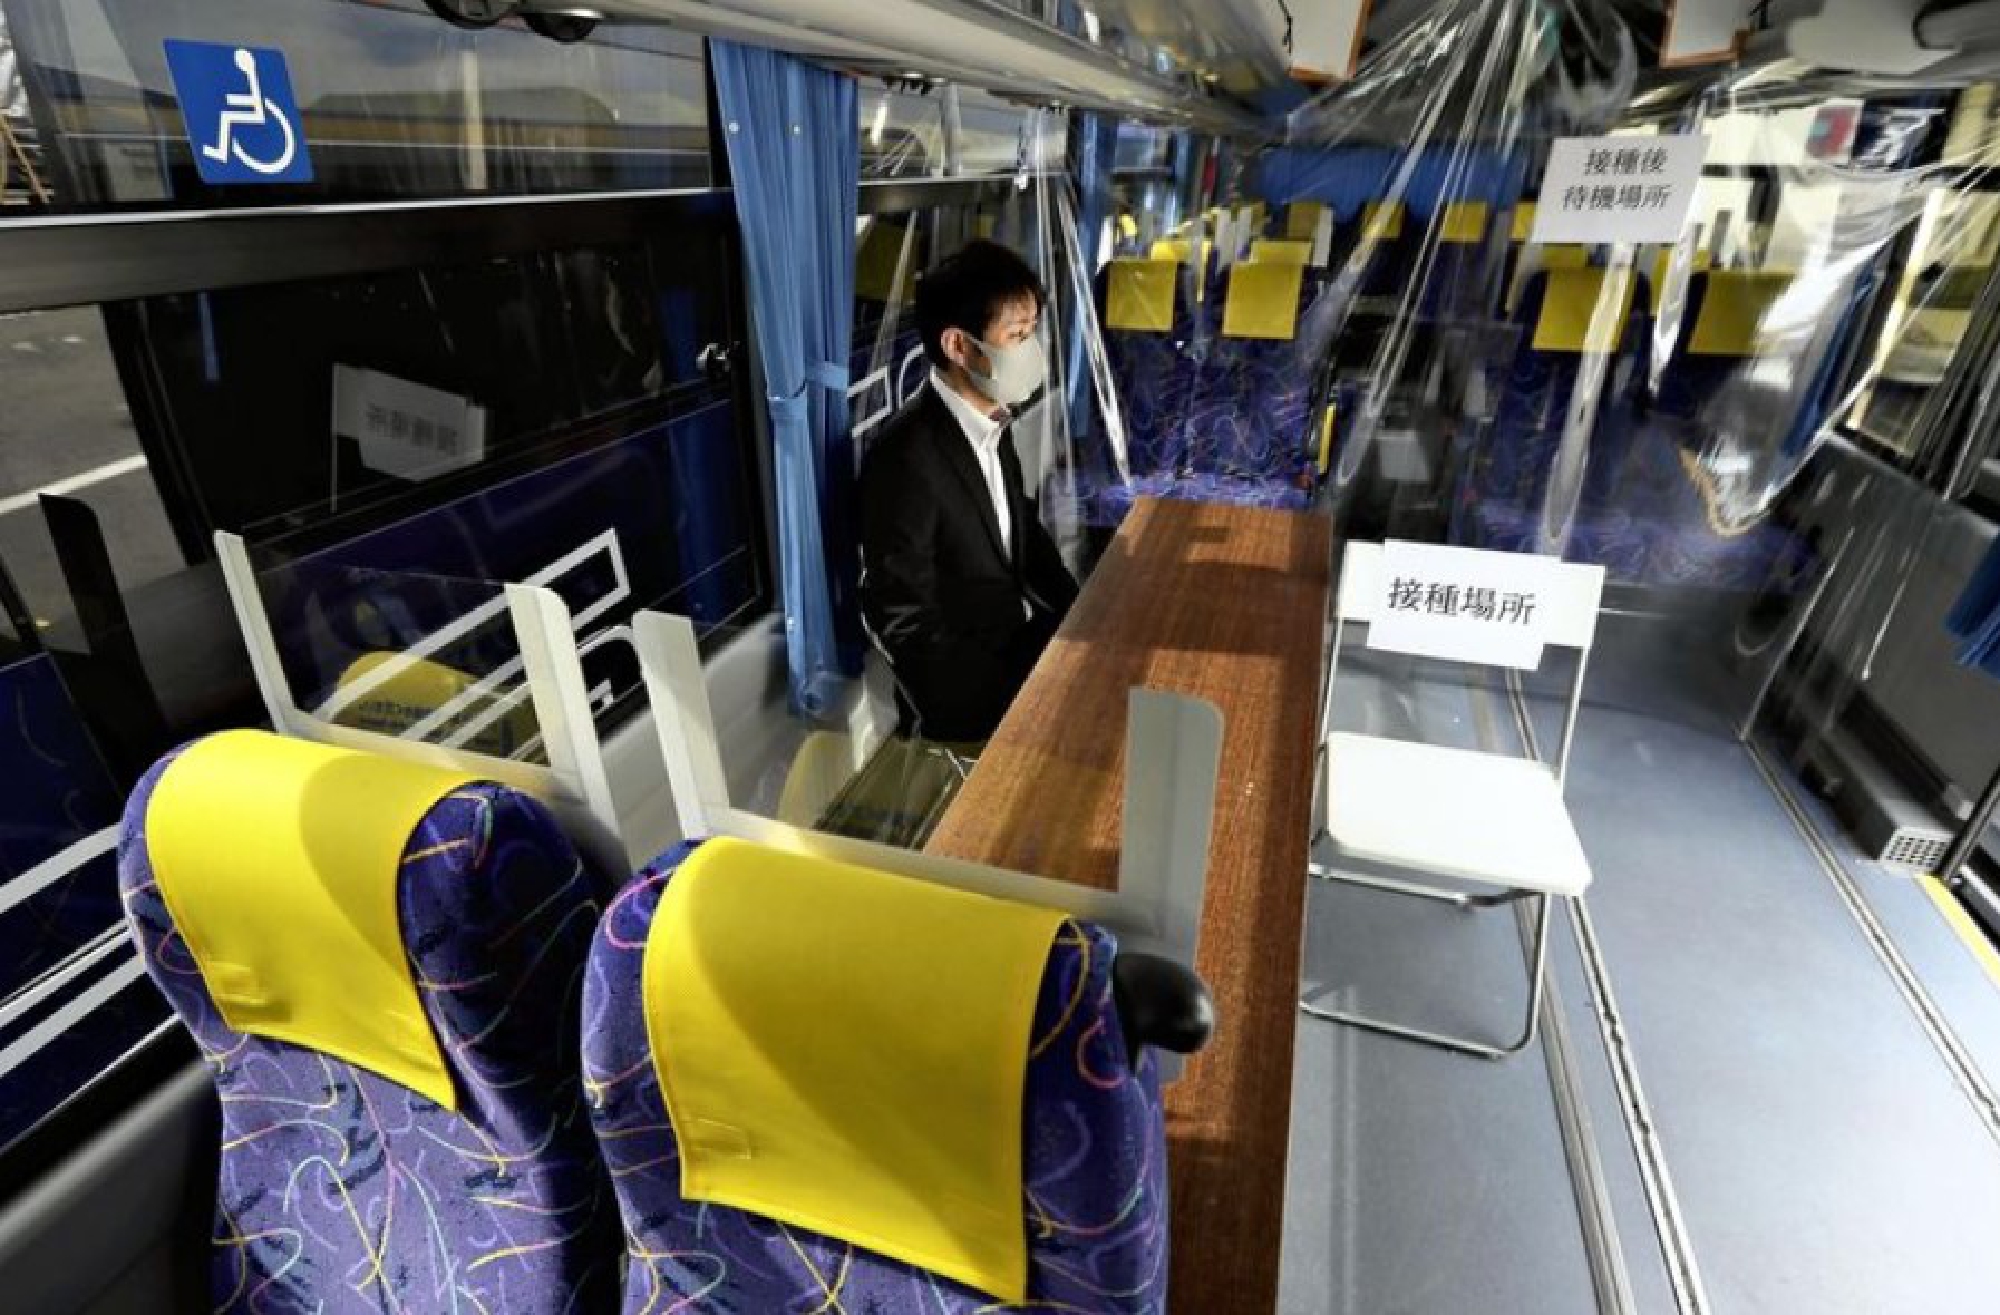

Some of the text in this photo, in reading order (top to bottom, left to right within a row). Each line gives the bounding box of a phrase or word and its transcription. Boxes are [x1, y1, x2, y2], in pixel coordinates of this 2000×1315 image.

[1585, 147, 1668, 175] 接種後
[1562, 184, 1672, 210] 待機場所
[1388, 576, 1535, 625] 接種場所
